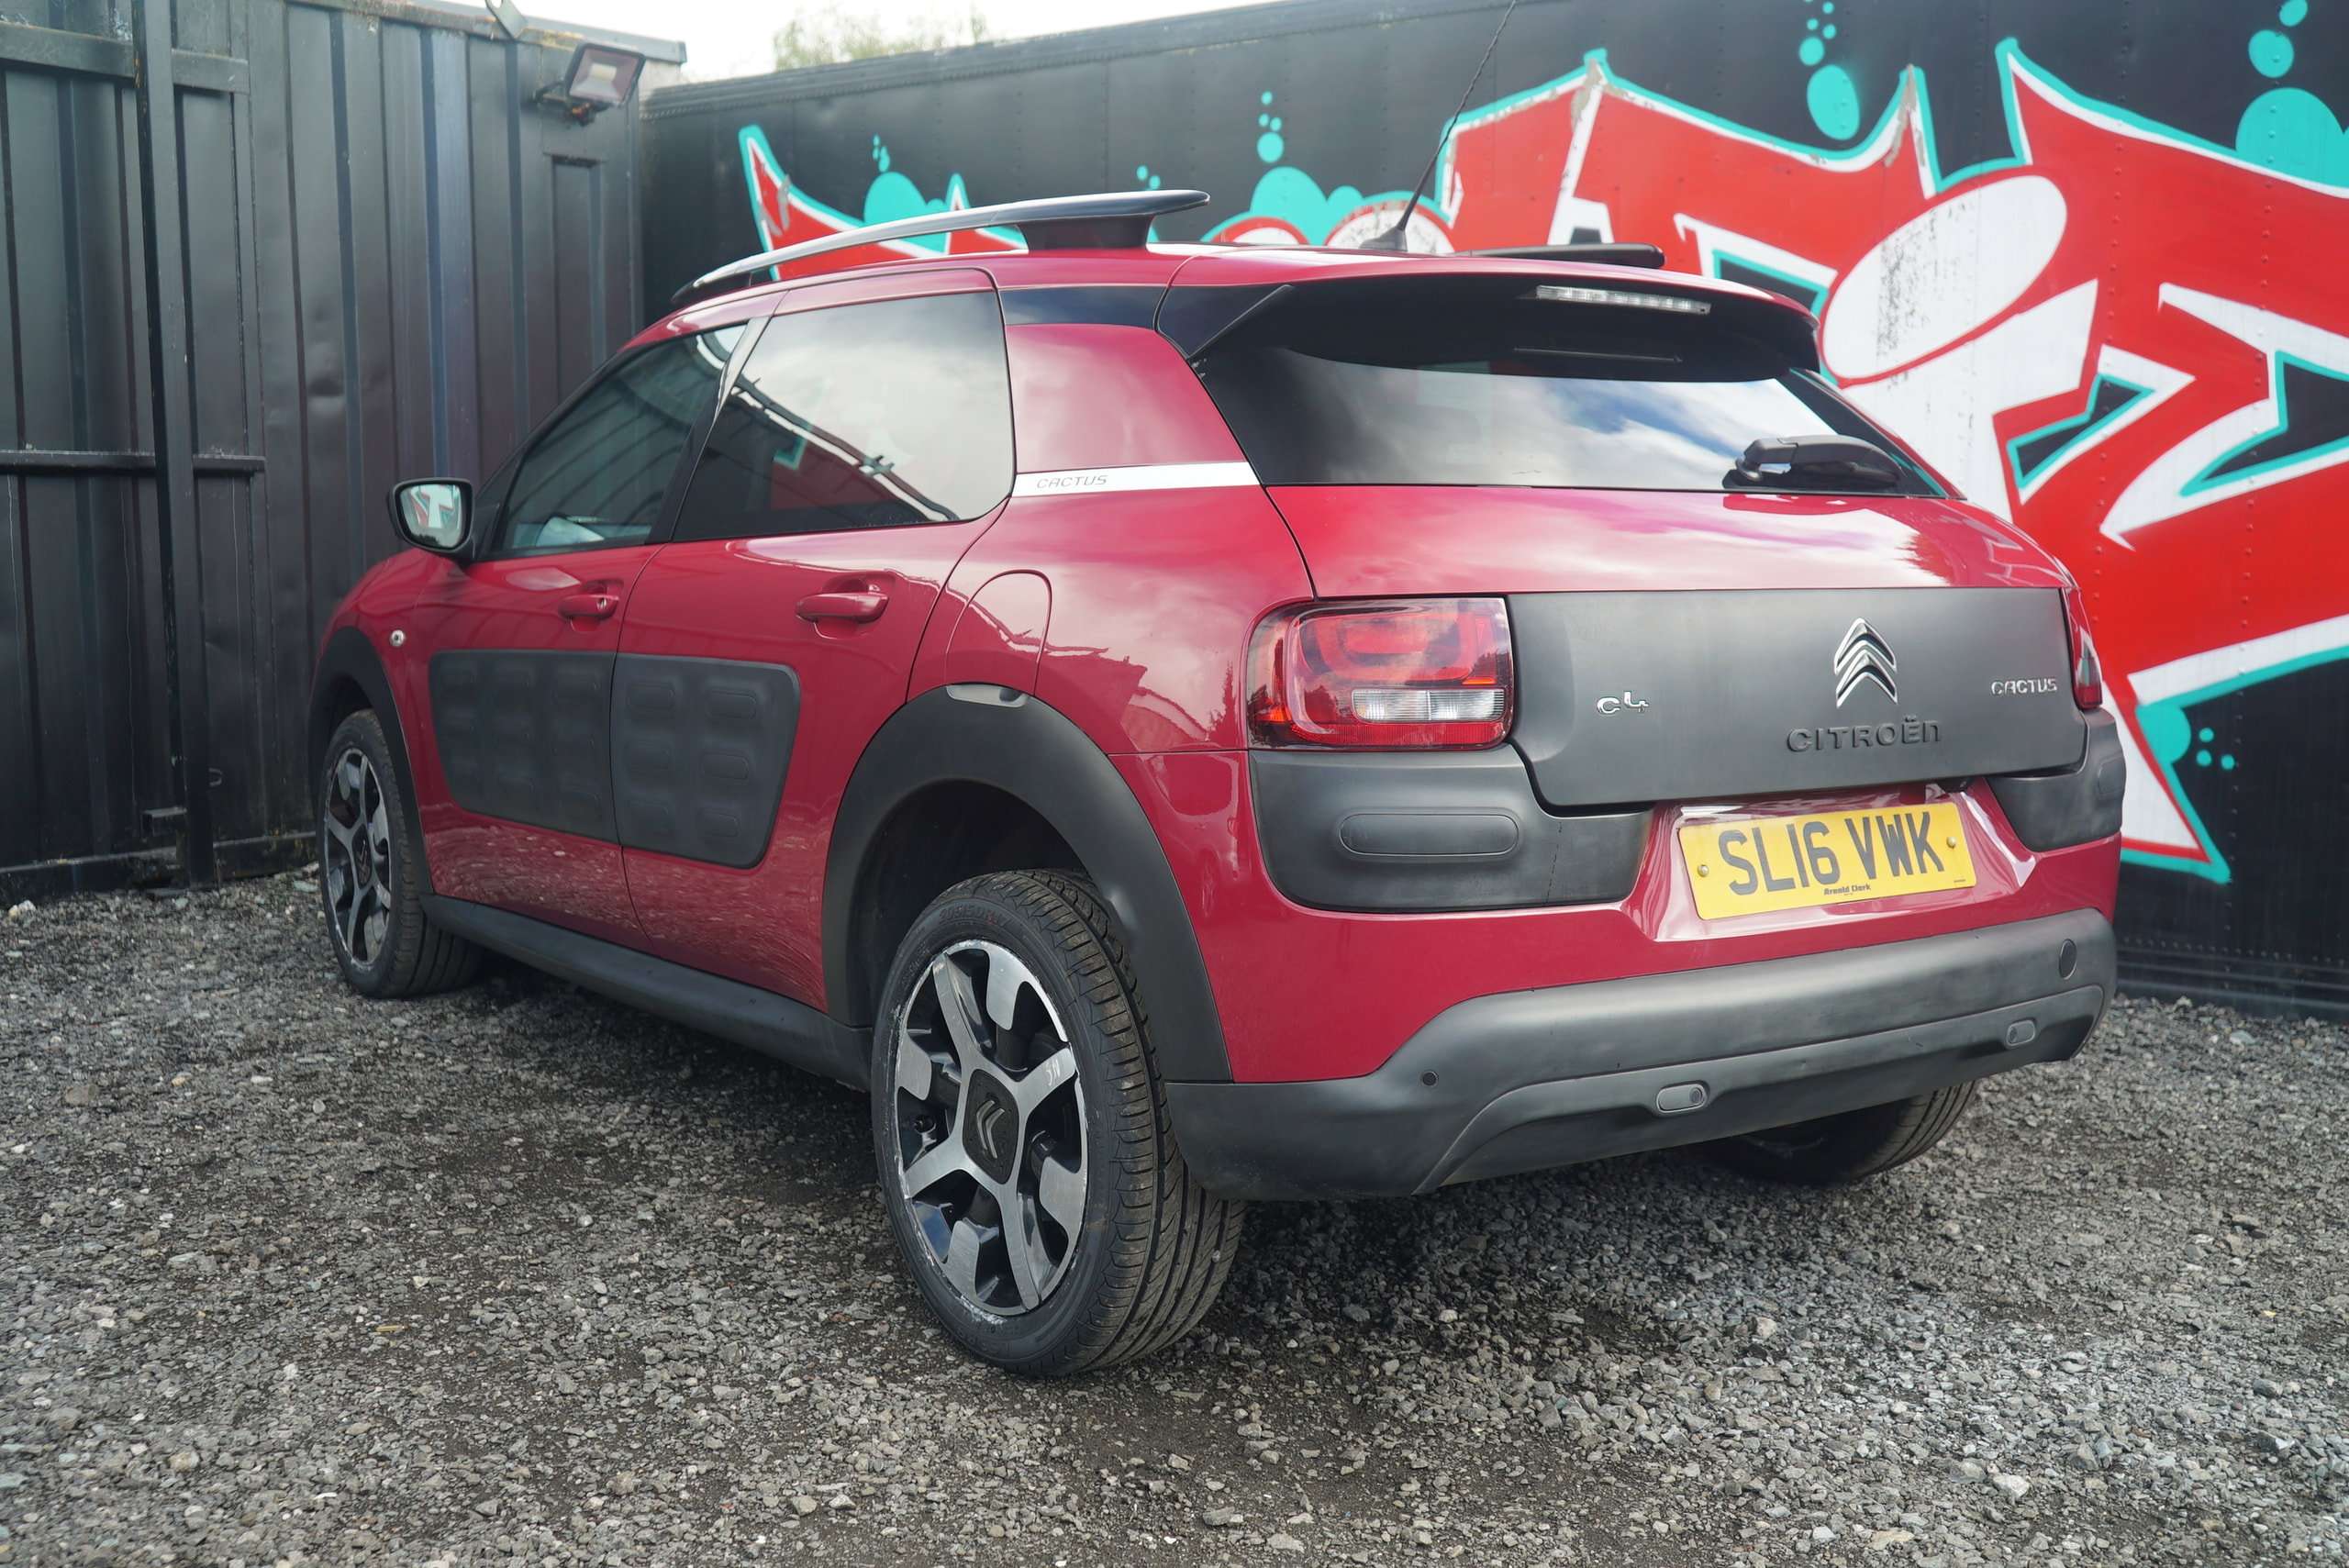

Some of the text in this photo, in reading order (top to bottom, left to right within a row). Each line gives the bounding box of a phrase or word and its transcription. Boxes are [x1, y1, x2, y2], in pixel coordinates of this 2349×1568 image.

[1036, 474, 1108, 489] CACTUS
[1990, 678, 2057, 695] CACTUS
[1597, 691, 1649, 713] C4
[1718, 811, 1945, 896] SL16 VWK
